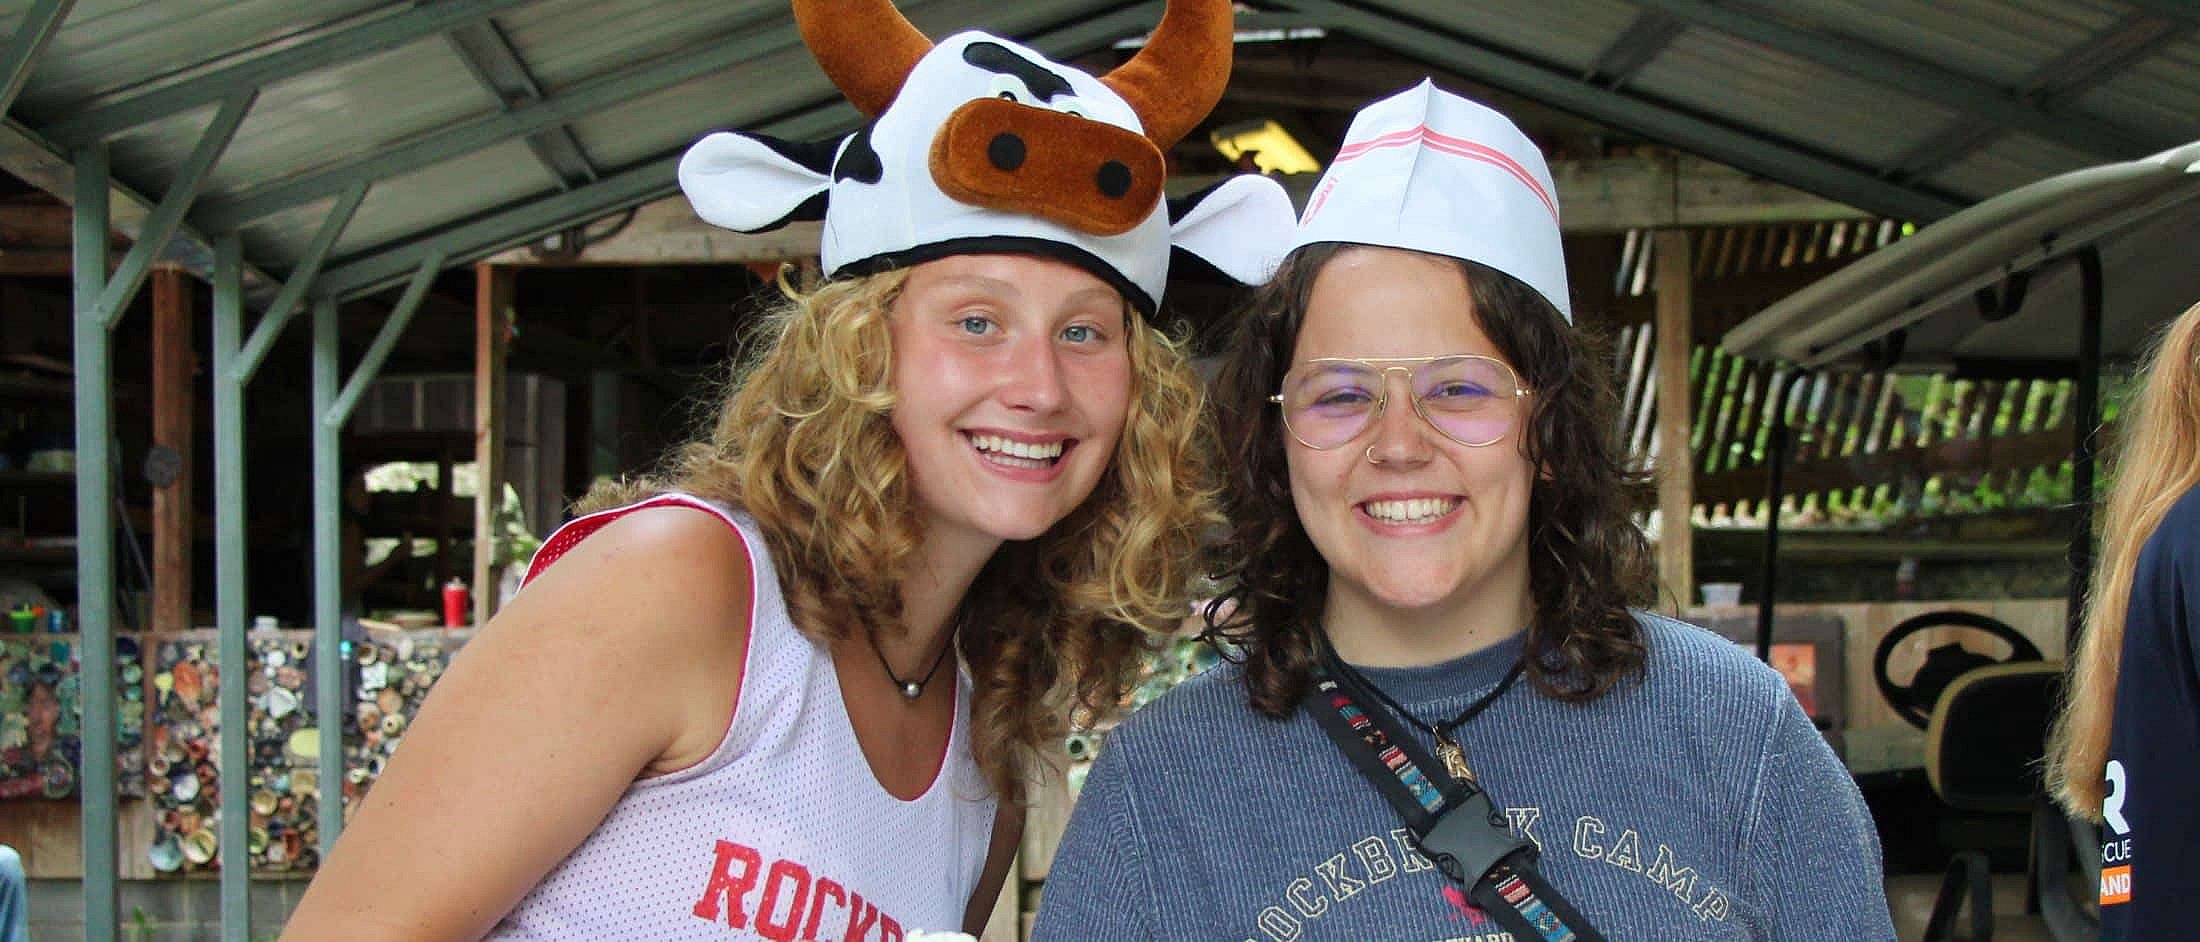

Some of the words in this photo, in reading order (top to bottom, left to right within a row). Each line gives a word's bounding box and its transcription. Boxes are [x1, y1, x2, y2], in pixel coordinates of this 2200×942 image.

[2101, 839, 2132, 864] CUE
[1574, 816, 1729, 921] CAMP
[2100, 873, 2131, 896] AND
